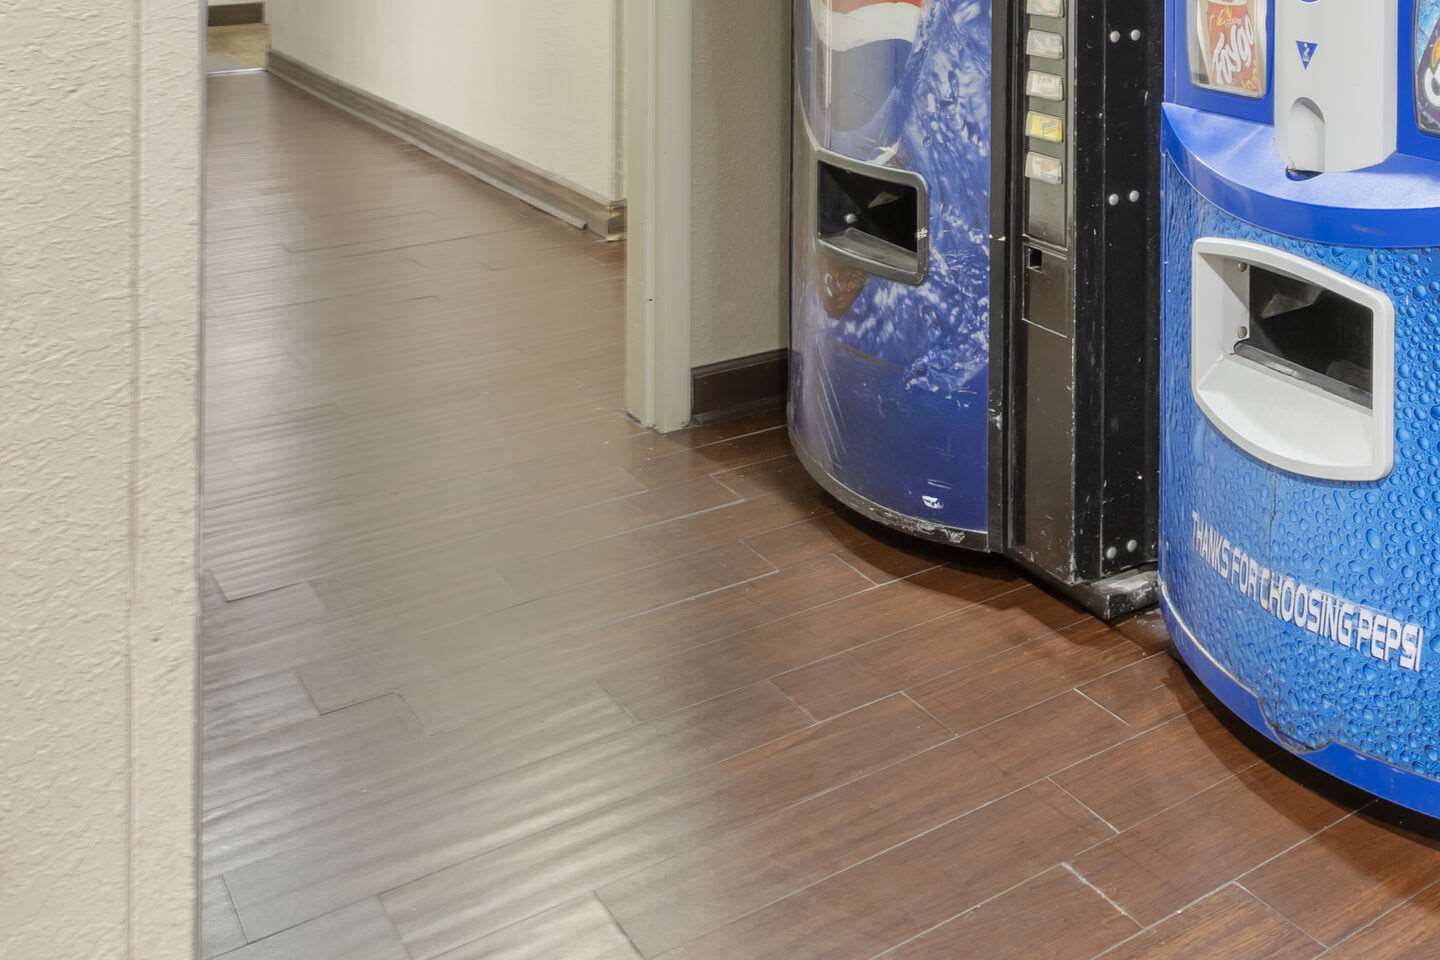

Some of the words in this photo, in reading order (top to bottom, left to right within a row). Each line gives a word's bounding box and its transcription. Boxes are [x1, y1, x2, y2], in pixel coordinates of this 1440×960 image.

[1192, 512, 1229, 578] THANKS
[1230, 546, 1262, 601] FOR
[1260, 568, 1353, 648] CHOOSING
[1355, 609, 1425, 672] PEPSI
